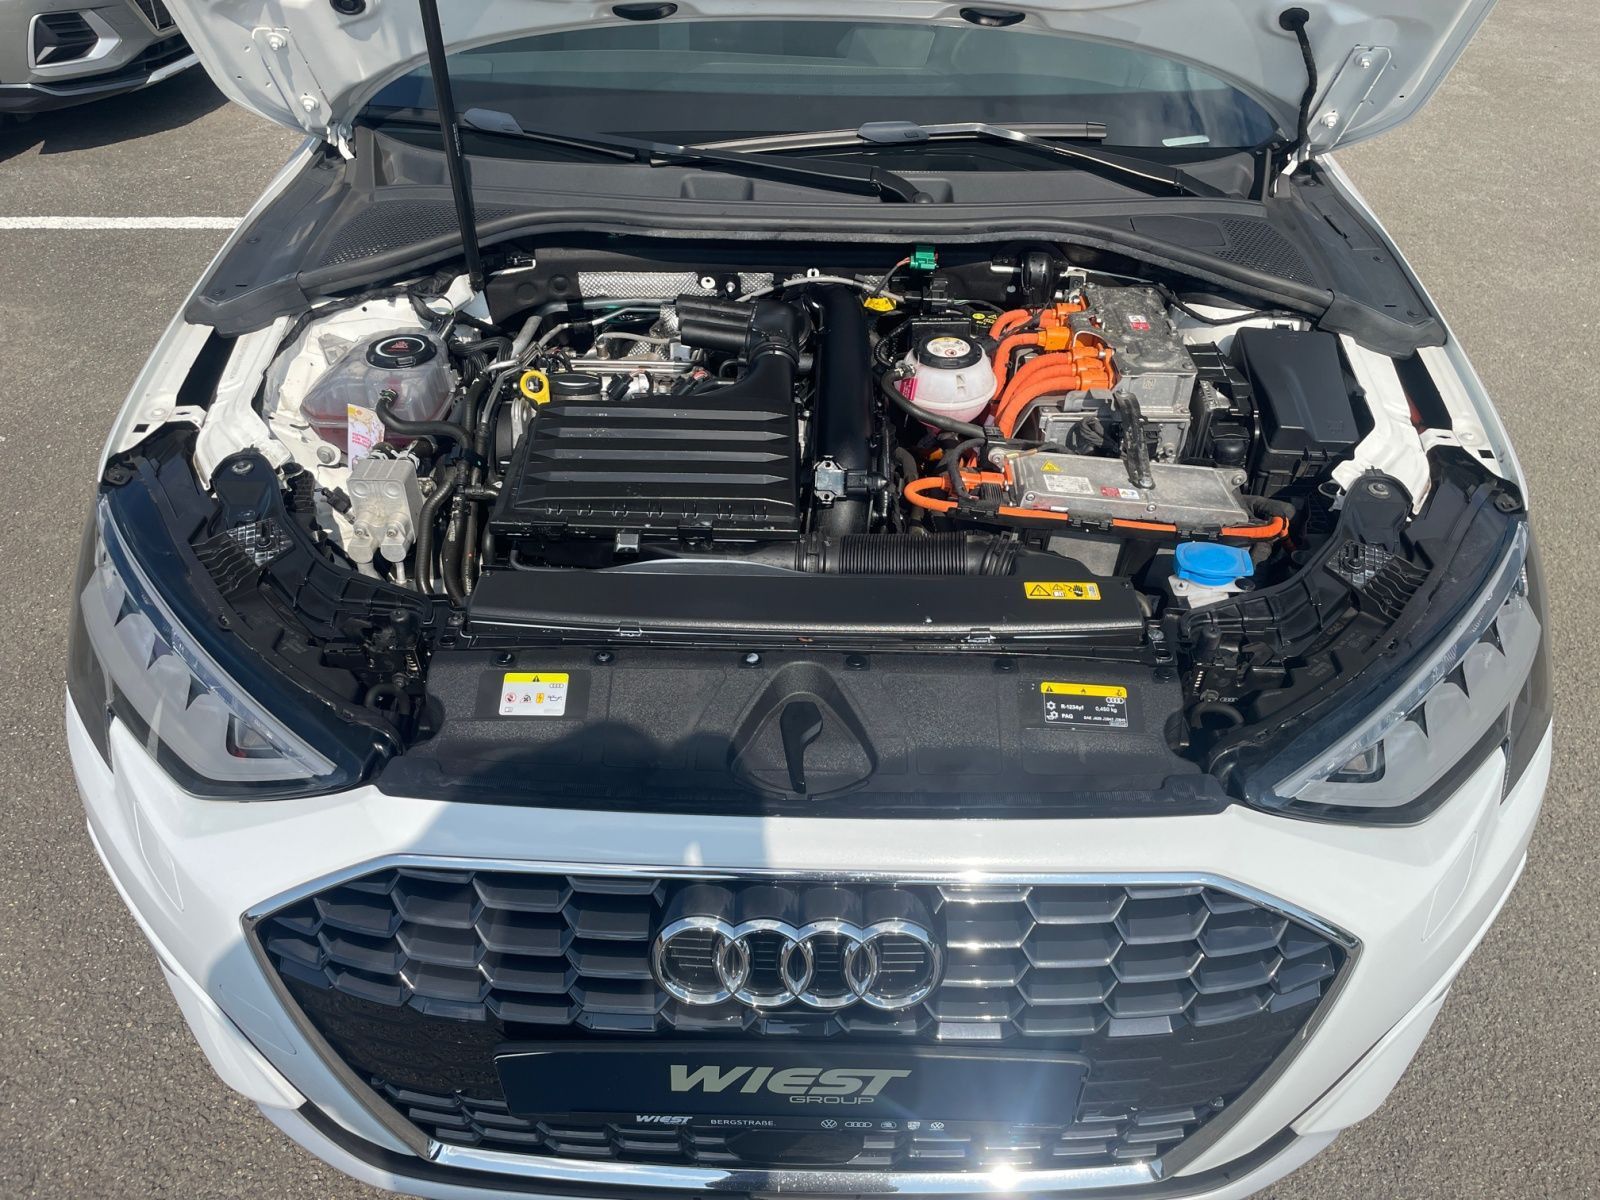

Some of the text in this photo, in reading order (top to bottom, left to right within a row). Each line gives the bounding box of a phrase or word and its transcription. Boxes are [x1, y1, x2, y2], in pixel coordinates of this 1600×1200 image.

[670, 1064, 912, 1096] WIEST
[789, 1095, 875, 1105] GROUP
[636, 1115, 693, 1125] WIEST
